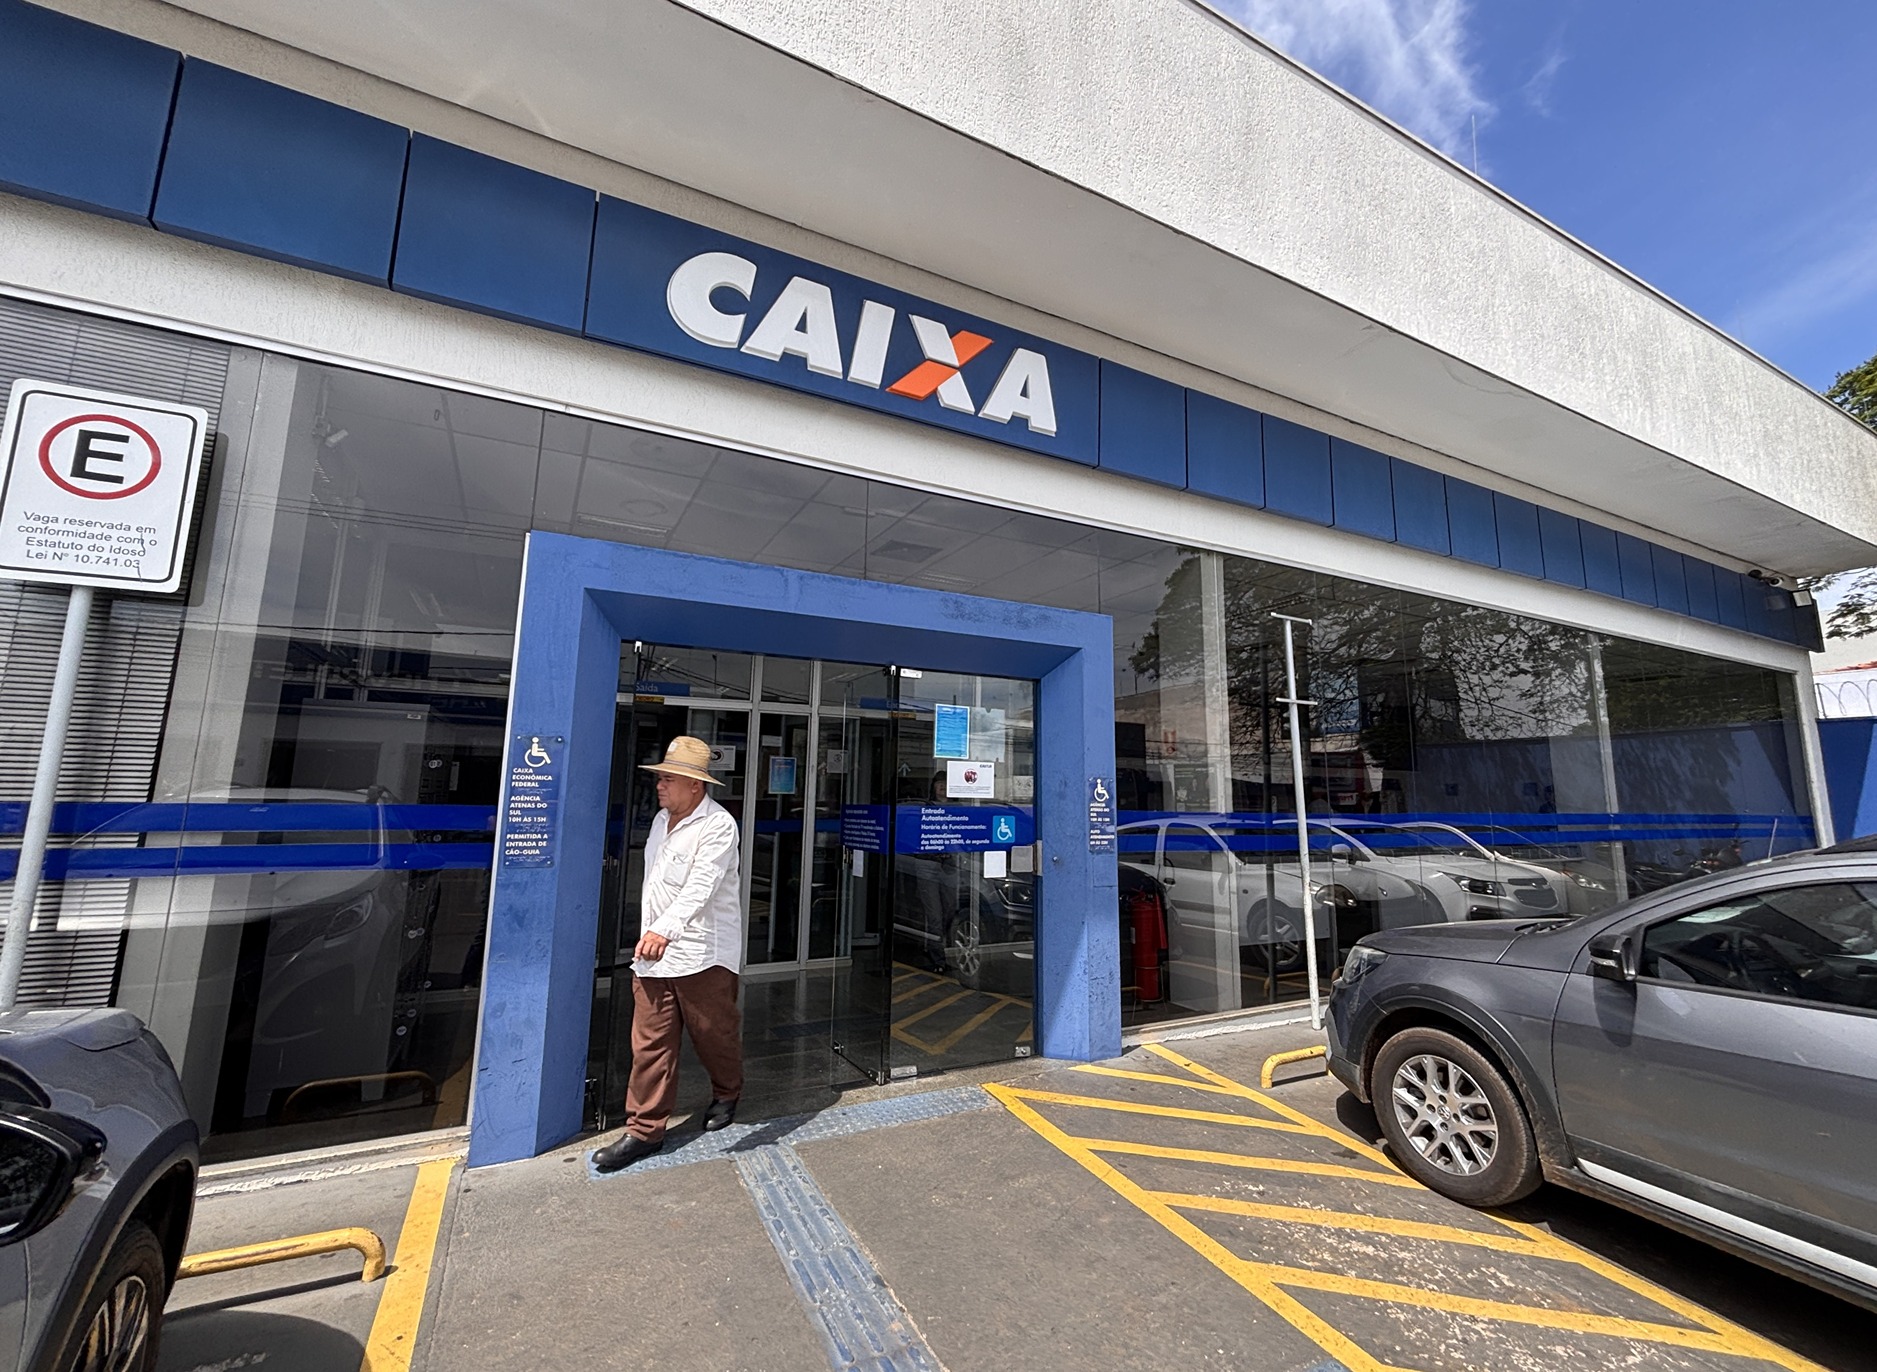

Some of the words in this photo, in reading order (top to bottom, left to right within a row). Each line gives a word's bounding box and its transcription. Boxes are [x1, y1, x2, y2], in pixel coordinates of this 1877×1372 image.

[666, 252, 1057, 437] CAIXA
[70, 429, 130, 484] E
[24, 511, 59, 525] Vaga
[63, 517, 131, 532] reservada
[135, 525, 156, 534] em
[17, 525, 113, 542] conformidade
[116, 535, 144, 545] com
[25, 536, 83, 551] Estatuto
[87, 543, 105, 553] do
[109, 545, 146, 557] Idoso
[26, 549, 48, 560] Lei
[74, 554, 140, 569] 10.741.03
[510, 794, 541, 802] AGÊNCIA
